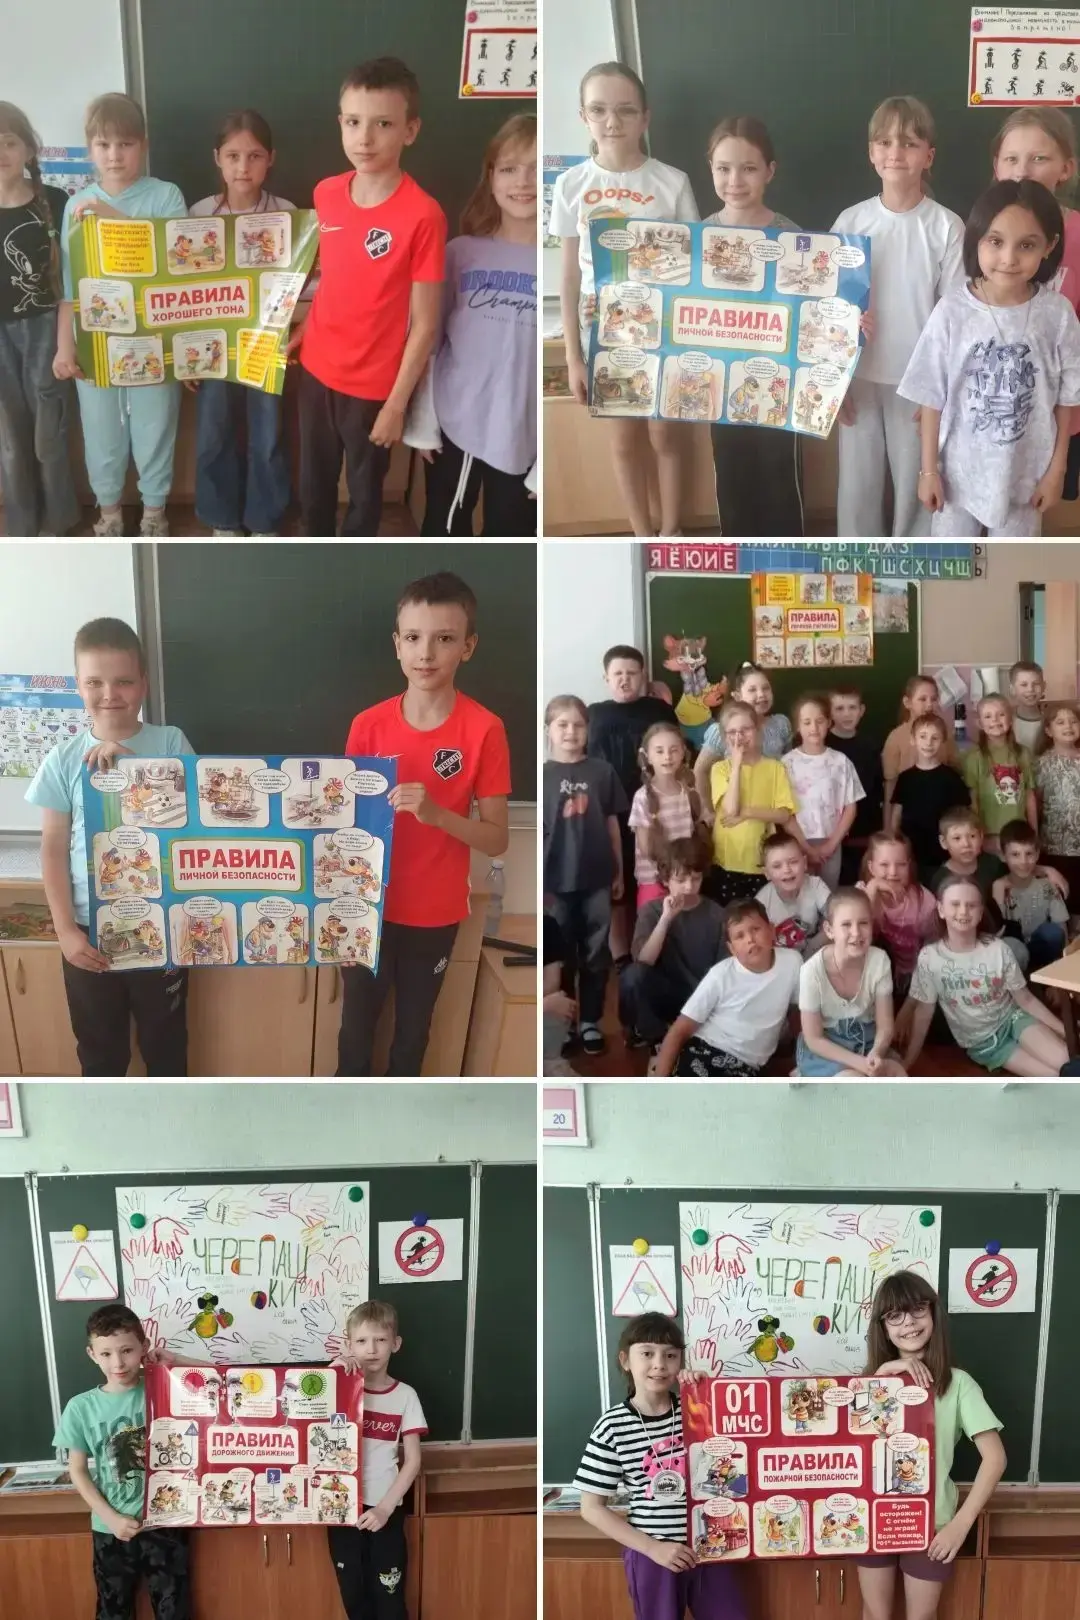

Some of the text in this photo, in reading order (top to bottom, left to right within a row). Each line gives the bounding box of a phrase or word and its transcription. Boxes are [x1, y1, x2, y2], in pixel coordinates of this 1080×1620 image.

[150, 285, 246, 309] ПРАВИЛА
[152, 305, 245, 322] ХОРОШЕГО ТОНА
[679, 305, 783, 332] ПРАВИЛА
[677, 326, 783, 343] ЛИЧНОЙ БЕЗОПАСНОСТИ
[791, 612, 837, 622] ПРАВИЛА
[179, 848, 296, 870] ПРАВИЛА
[179, 870, 296, 882] ЛИЧНОЙ БЕЗОПАСНОСТИ
[552, 1113, 566, 1124] 20
[268, 1278, 297, 1308] КИ
[830, 1302, 862, 1335] КИ
[725, 1383, 757, 1414] 01
[722, 1414, 763, 1433] МЧС
[212, 1432, 295, 1449] ПРАВИЛА
[212, 1449, 295, 1457] ДОРОЖНОГО ДВИЖЕНИЯ
[763, 1452, 859, 1472] ПРАВИЛА
[763, 1473, 859, 1484] ПОЖАРНОЙ БЕЗОПАСНОСТИ
[879, 1510, 923, 1518] осторожен!
[891, 1503, 910, 1511] Будь
